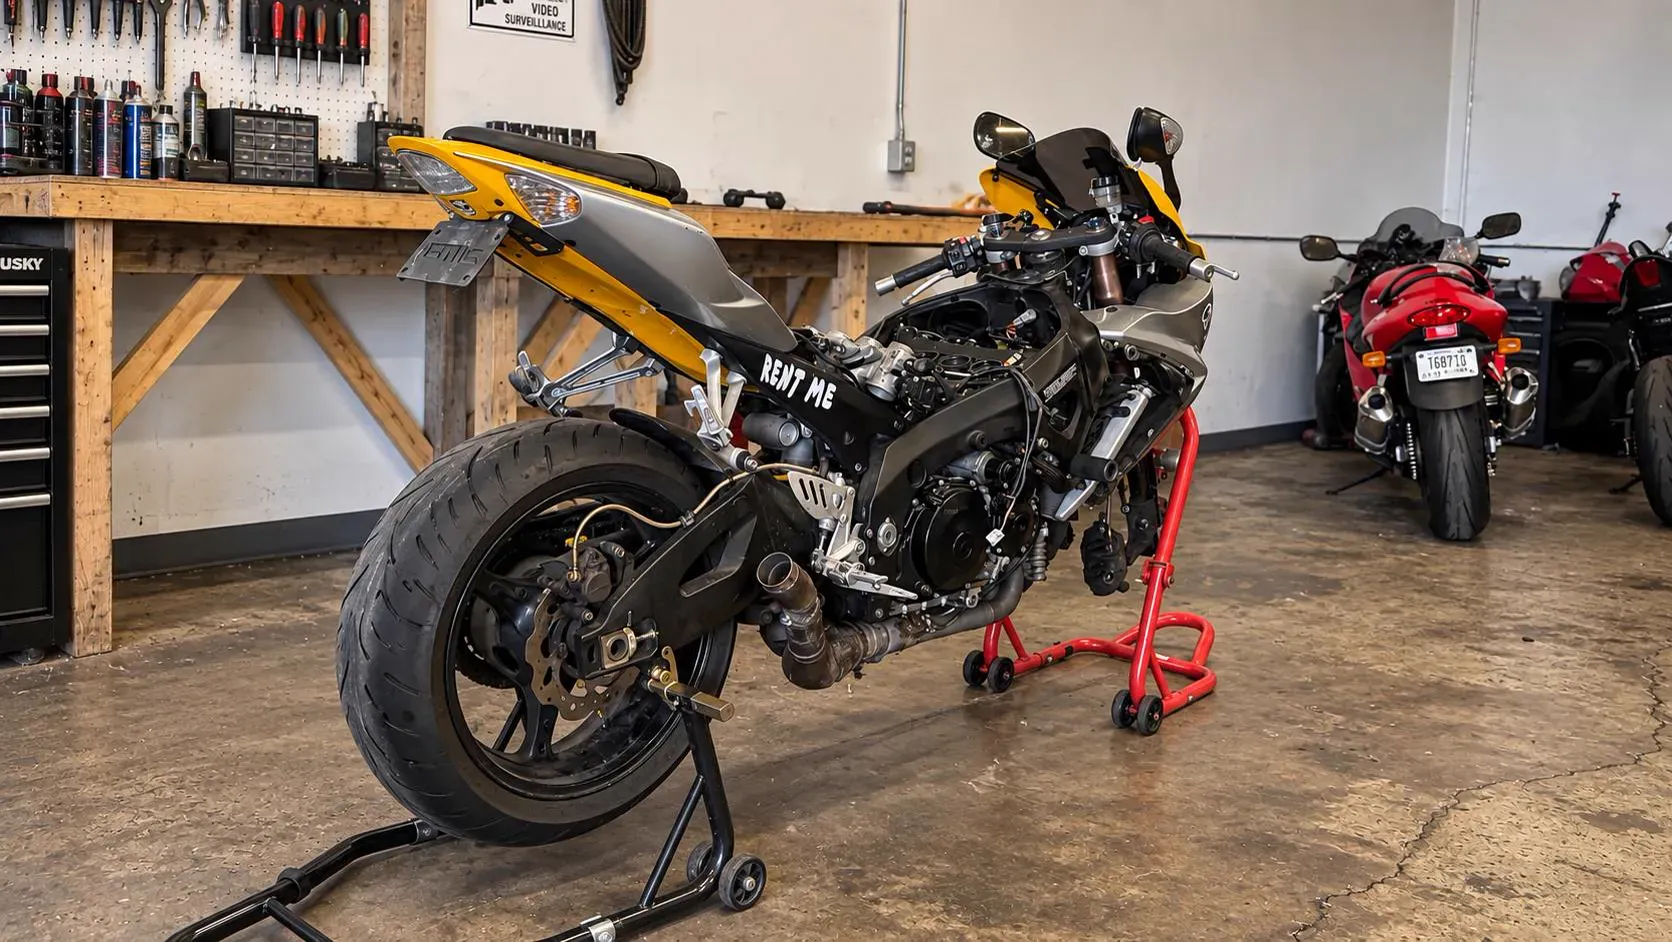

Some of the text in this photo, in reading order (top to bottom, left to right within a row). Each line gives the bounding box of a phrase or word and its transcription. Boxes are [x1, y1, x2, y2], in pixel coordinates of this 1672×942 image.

[531, 2, 559, 17] VIDEO
[760, 353, 837, 410] RENT ME
